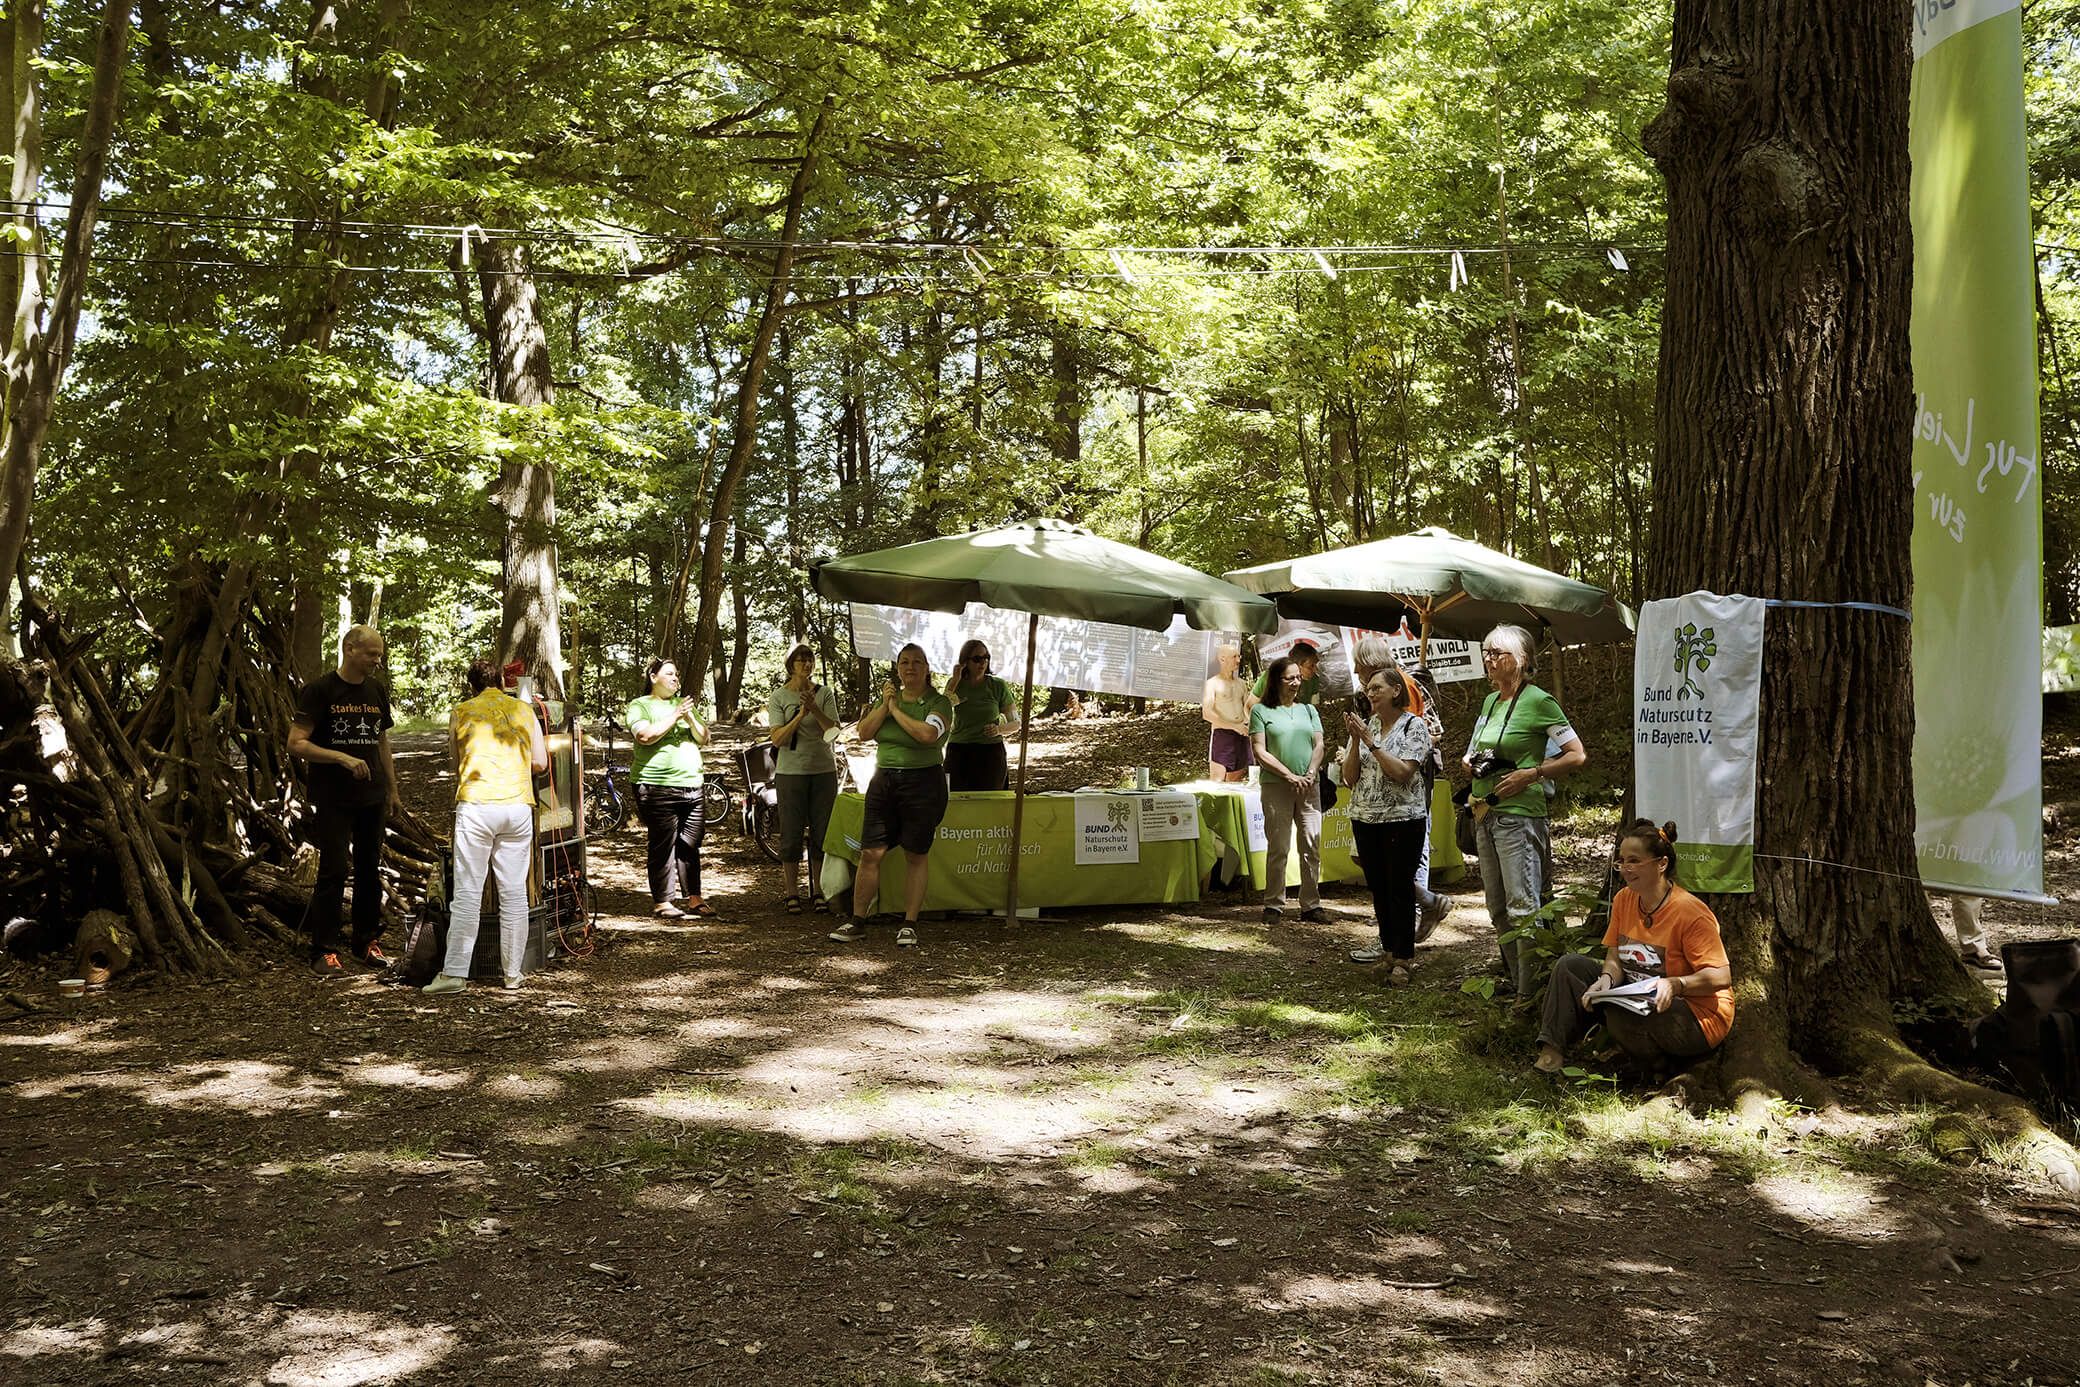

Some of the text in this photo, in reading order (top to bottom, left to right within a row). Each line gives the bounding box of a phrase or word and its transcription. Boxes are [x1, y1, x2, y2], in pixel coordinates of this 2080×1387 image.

[1392, 640, 1469, 660] SEREM WALD
[1644, 685, 1672, 702] Bund
[330, 704, 362, 714] Starkes
[1637, 729, 1648, 743] in
[1085, 825, 1110, 834] BUND
[1336, 820, 1347, 833] für
[941, 827, 983, 842] Bayern
[1085, 834, 1128, 843] Naturschutz
[1085, 845, 1092, 853] in
[1093, 845, 1117, 854] Bayern
[1324, 837, 1339, 849] und
[976, 842, 1041, 858] für Mesch
[957, 861, 1011, 874] und Natu
